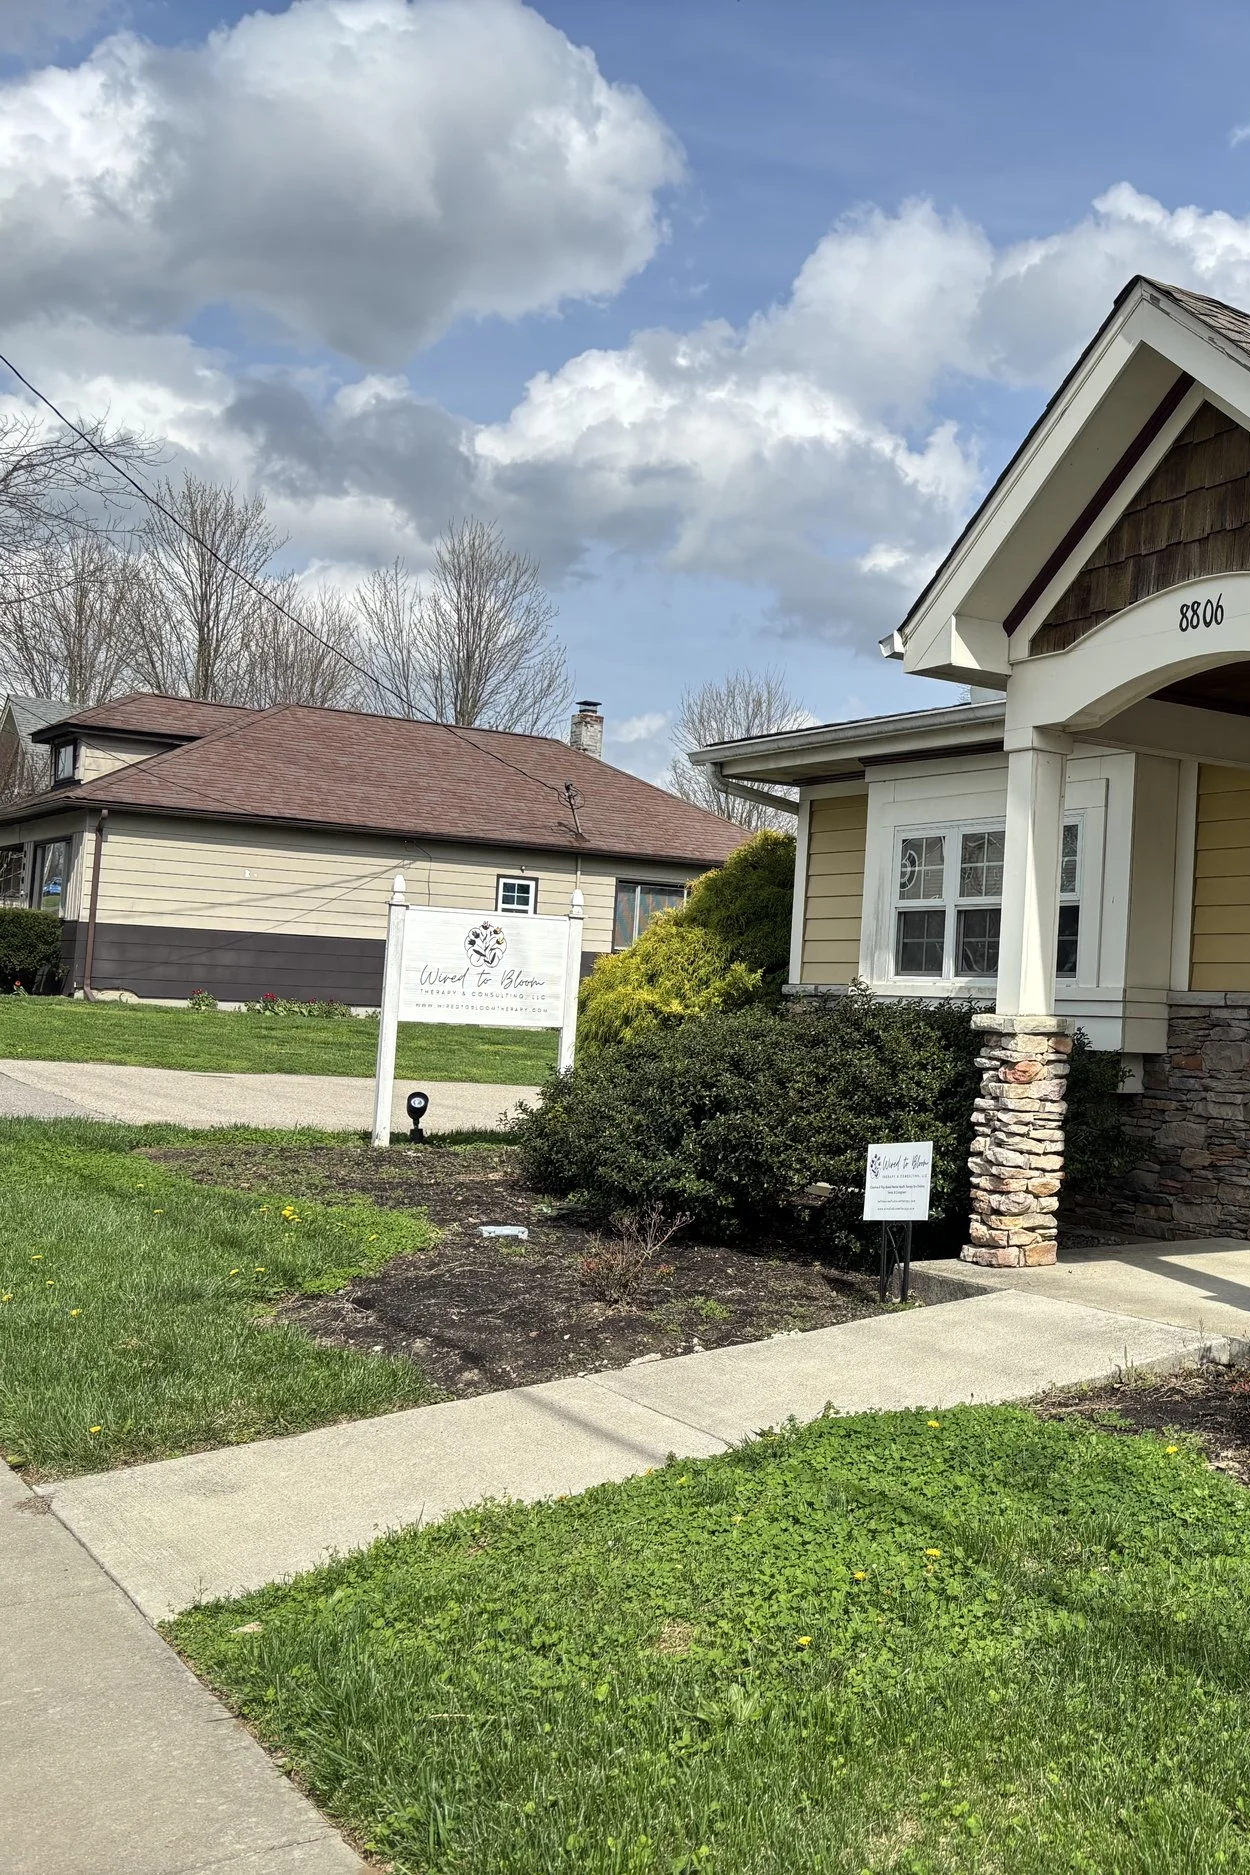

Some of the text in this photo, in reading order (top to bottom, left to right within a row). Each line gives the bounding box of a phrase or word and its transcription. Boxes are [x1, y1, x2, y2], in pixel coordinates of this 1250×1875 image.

[1179, 593, 1223, 632] 8806
[420, 964, 546, 990] Wired to Bloom
[420, 988, 457, 996] THERAPY
[882, 1155, 902, 1171] Wired
[902, 1156, 909, 1170] to
